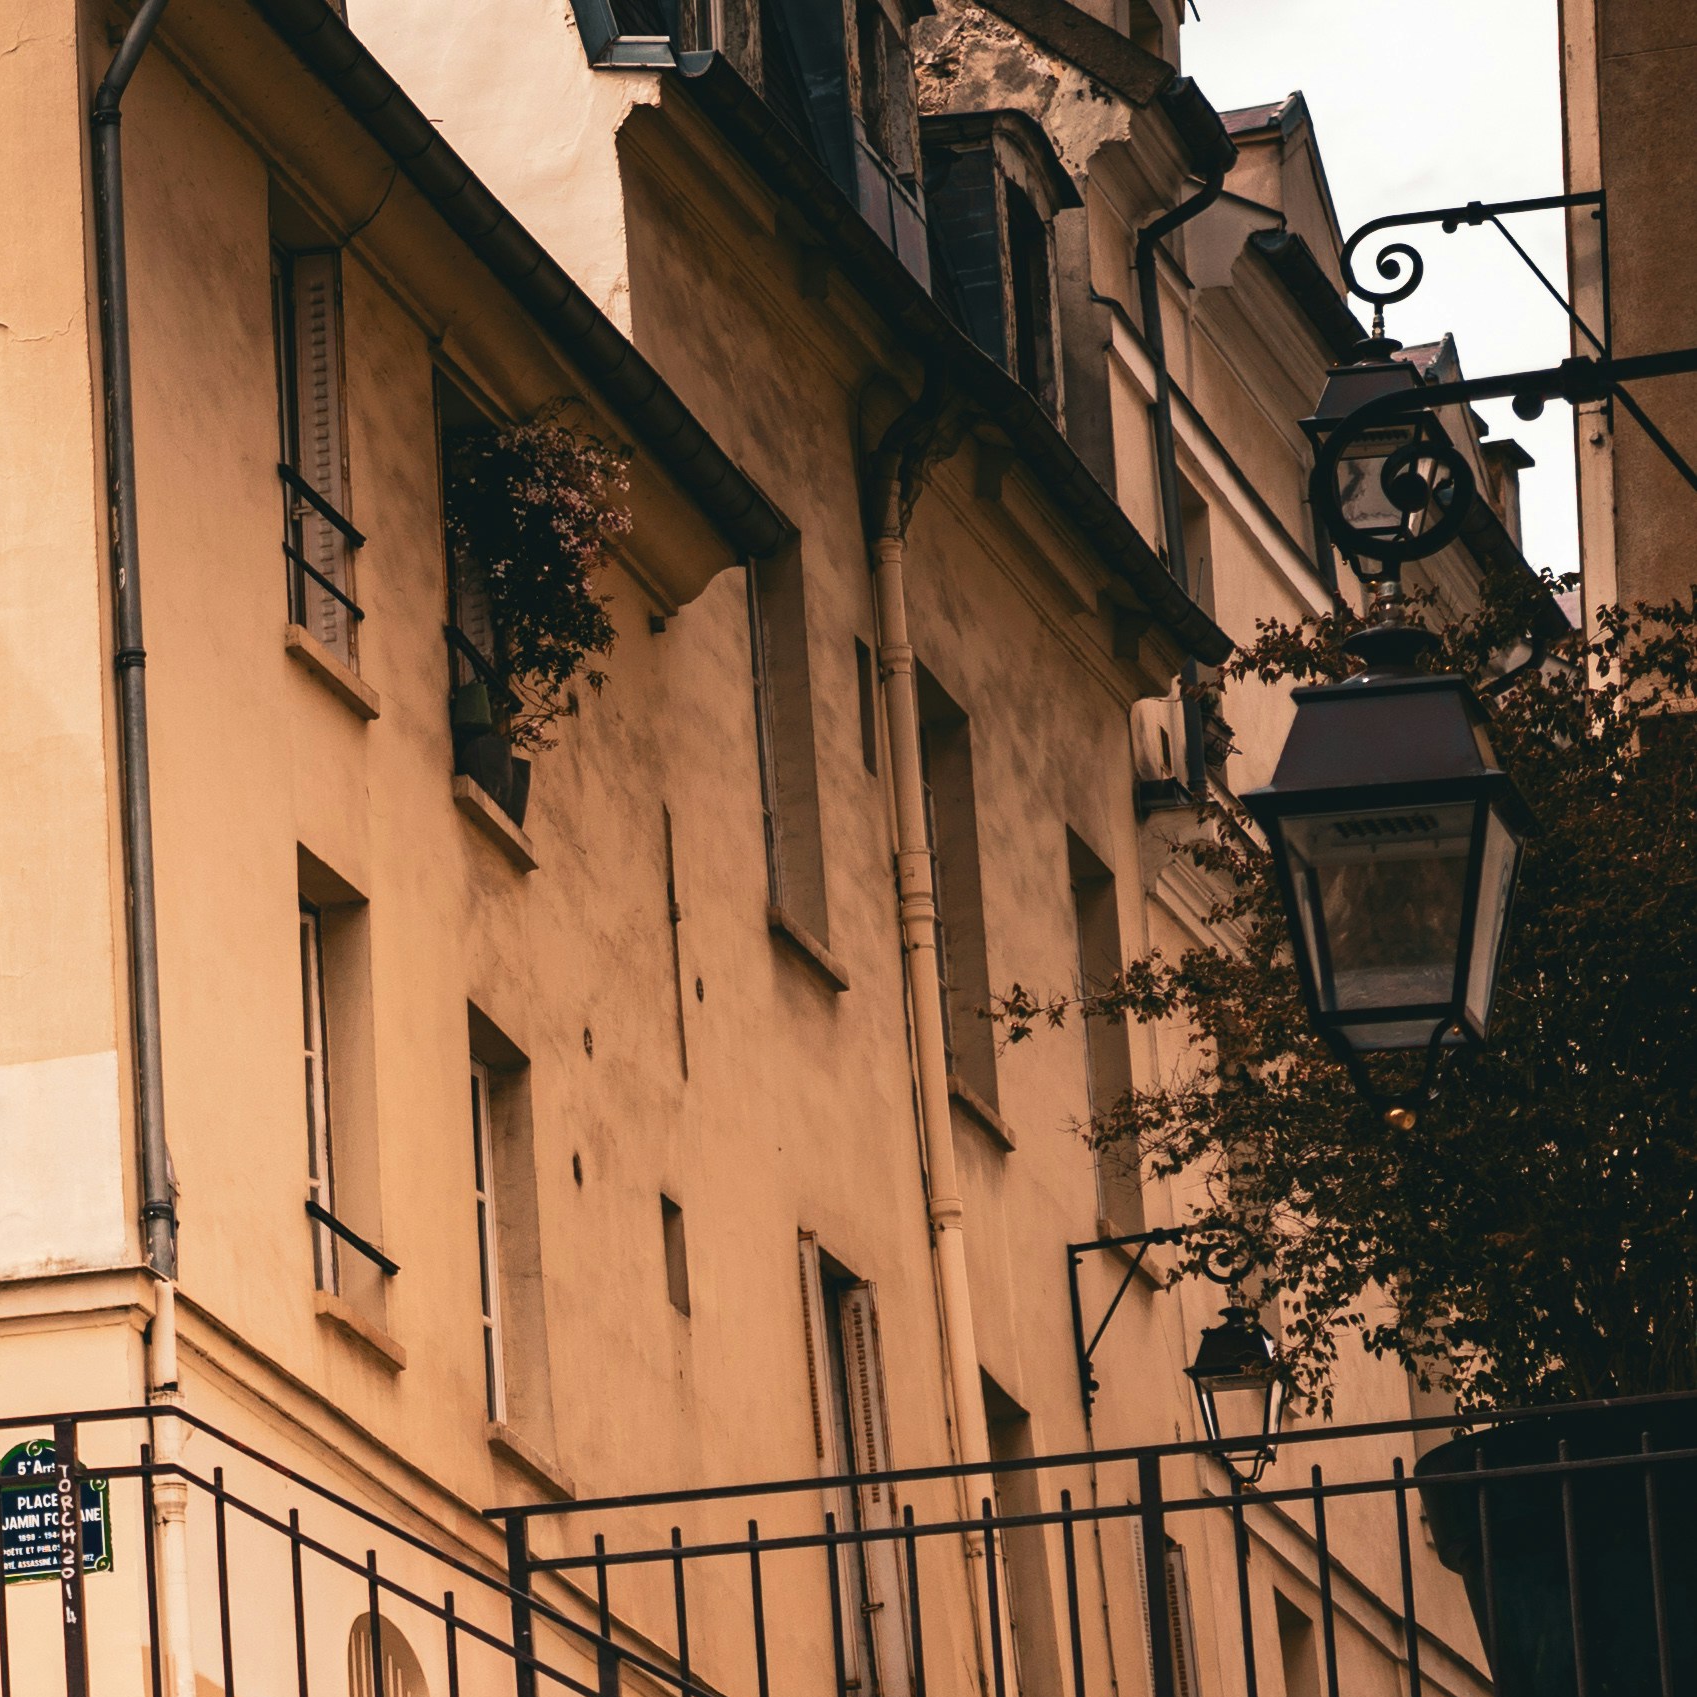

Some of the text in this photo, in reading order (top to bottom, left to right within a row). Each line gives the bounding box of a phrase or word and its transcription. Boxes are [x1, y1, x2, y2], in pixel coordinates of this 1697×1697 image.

[17, 1493, 58, 1510] PLACE
[44, 1508, 102, 1526] FOANE
[18, 1533, 36, 1542] 1898
[26, 1546, 34, 1554] ET
